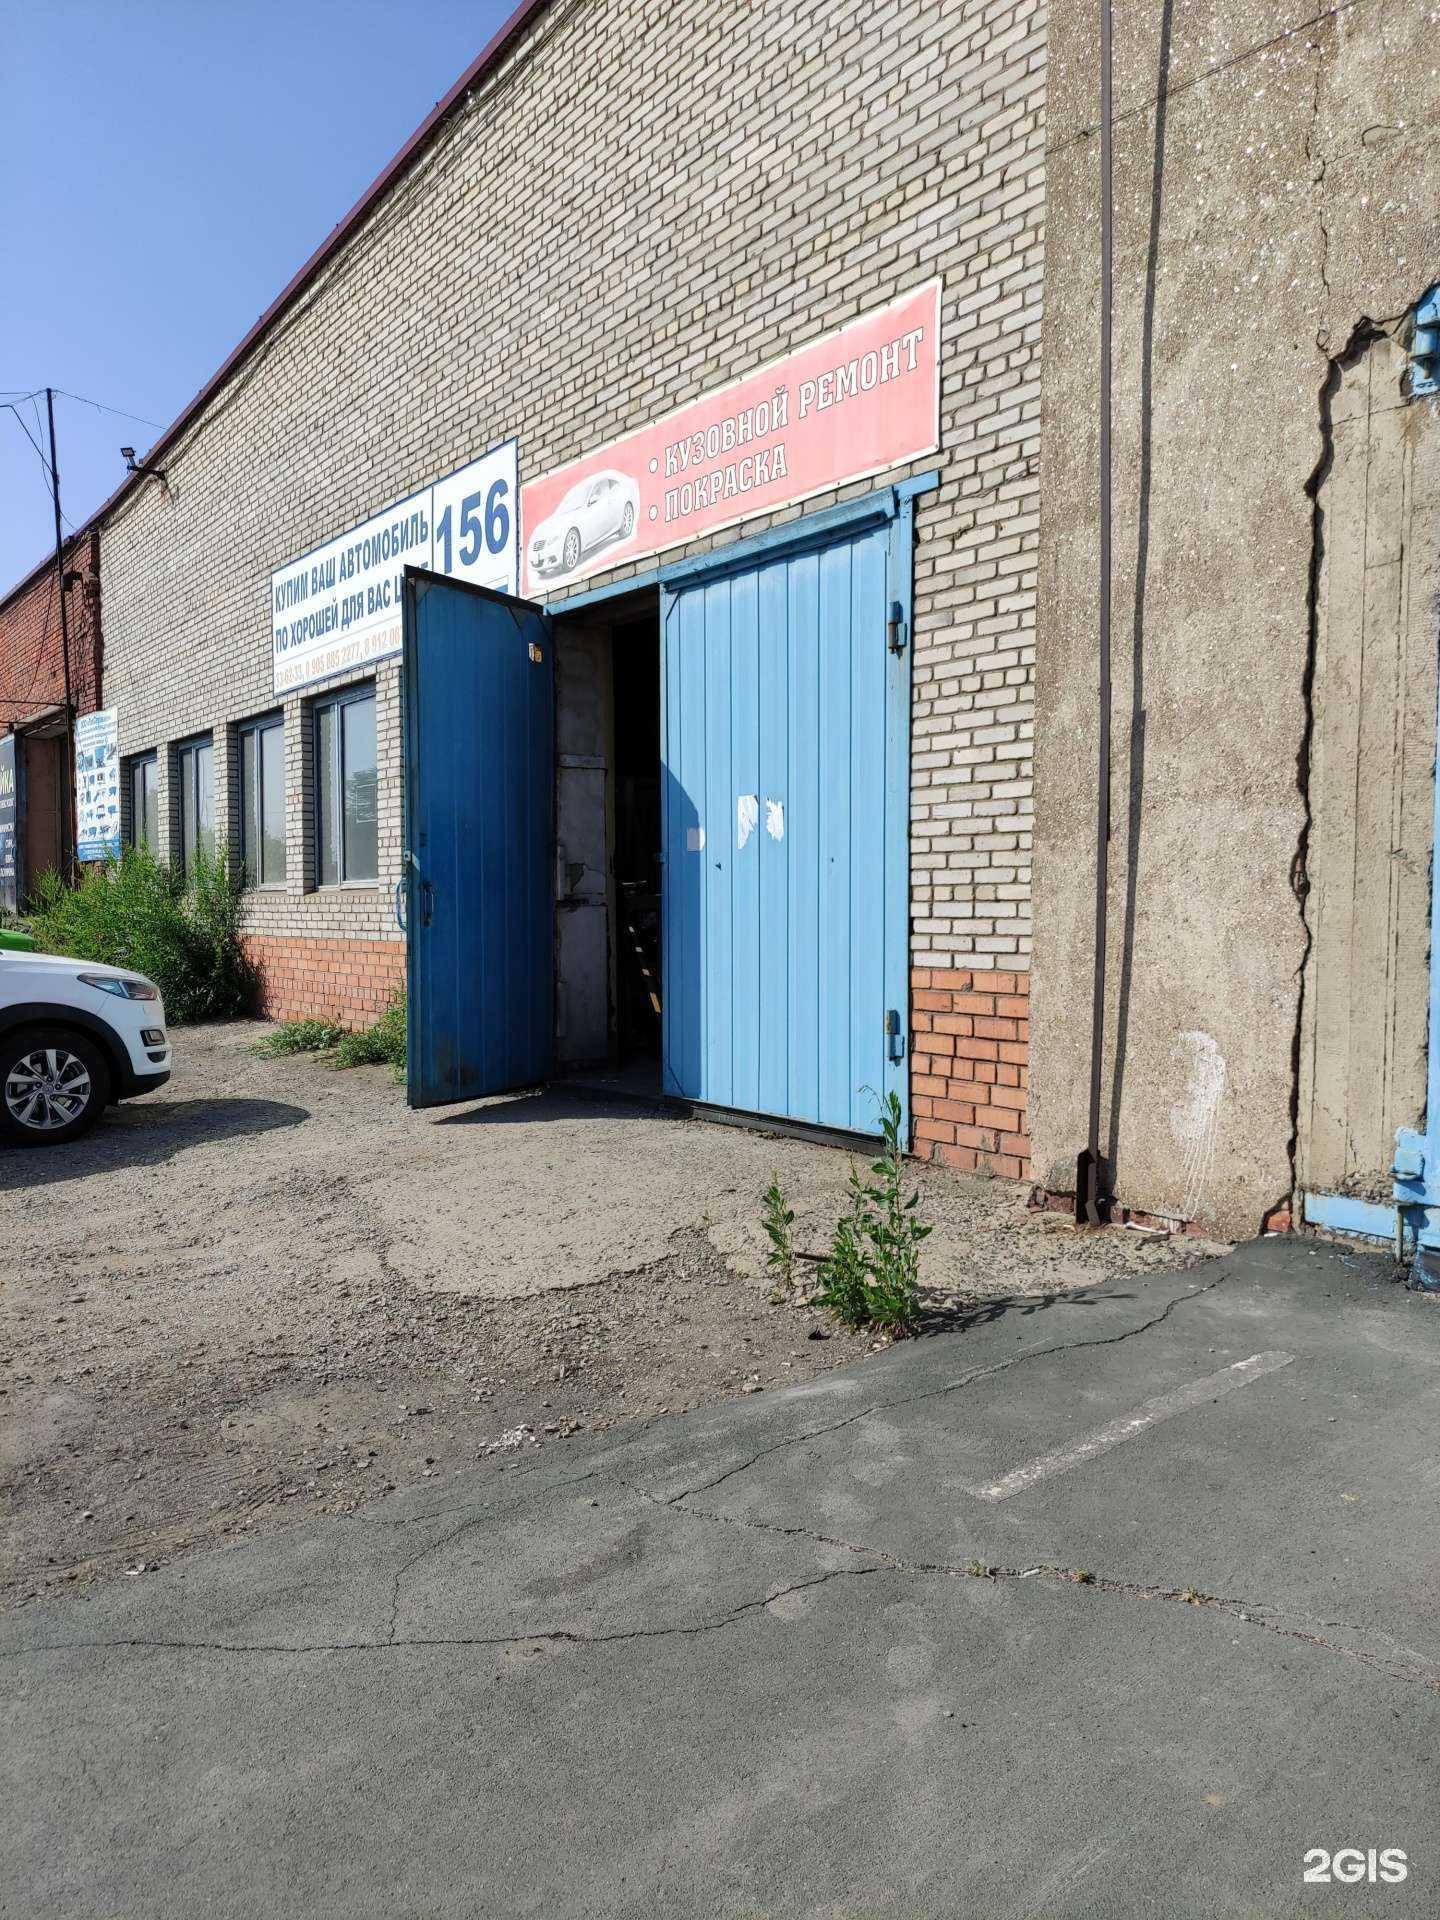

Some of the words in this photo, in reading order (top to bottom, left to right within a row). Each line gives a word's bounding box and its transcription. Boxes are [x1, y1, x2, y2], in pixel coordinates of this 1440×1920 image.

[664, 386, 789, 478] КУЗОВНОЙ
[799, 327, 925, 420] РЕМОНТ
[437, 479, 509, 574] 156
[664, 444, 788, 523] ПОКРАСКА
[275, 573, 308, 613] КУПИМ
[311, 557, 335, 596] ВАШ
[339, 510, 428, 583] АВТОМОБИЛЬ
[275, 626, 288, 654] ПО
[290, 597, 339, 648] ХОРОШЕЙ
[341, 592, 364, 631] ДЛЯ
[367, 582, 391, 615] ВАС
